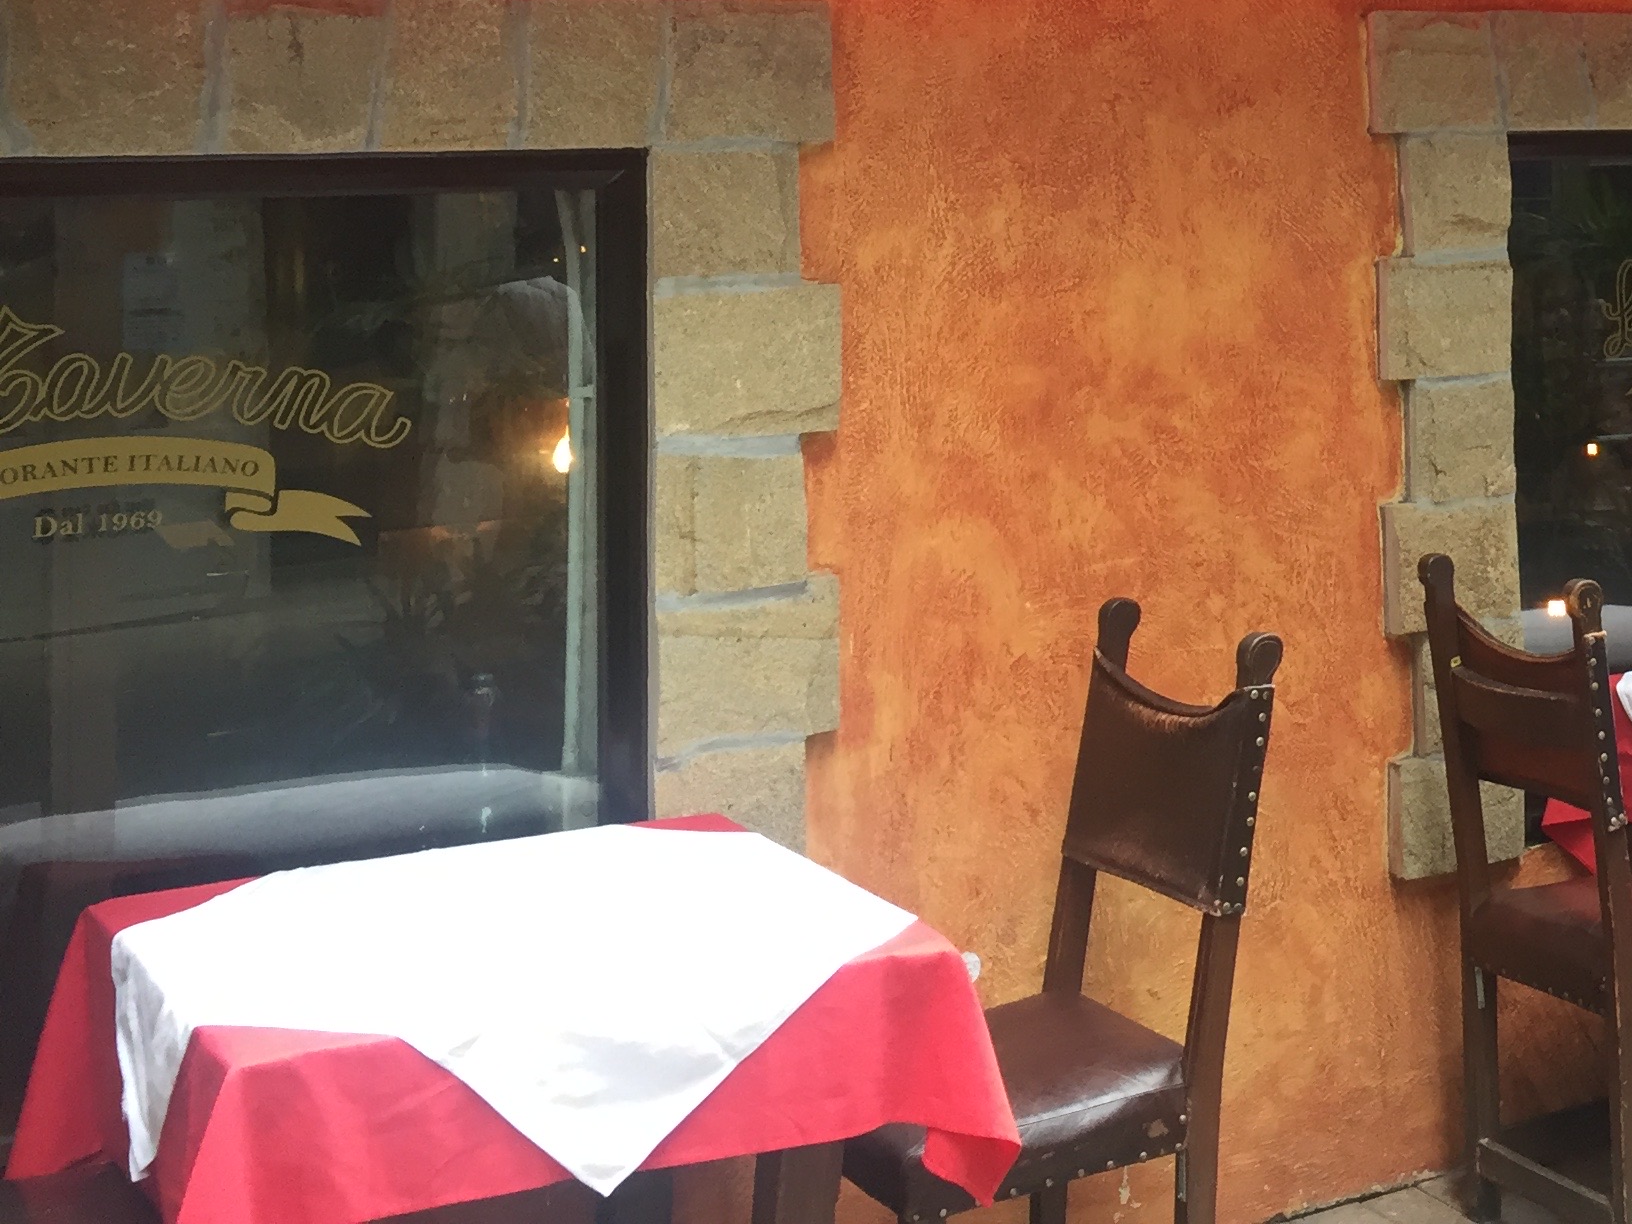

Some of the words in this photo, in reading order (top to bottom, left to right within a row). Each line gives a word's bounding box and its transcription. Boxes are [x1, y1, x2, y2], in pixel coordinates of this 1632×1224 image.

[127, 453, 260, 477] ITALIANO
[31, 512, 84, 540] Dal
[97, 508, 163, 533] 1969
